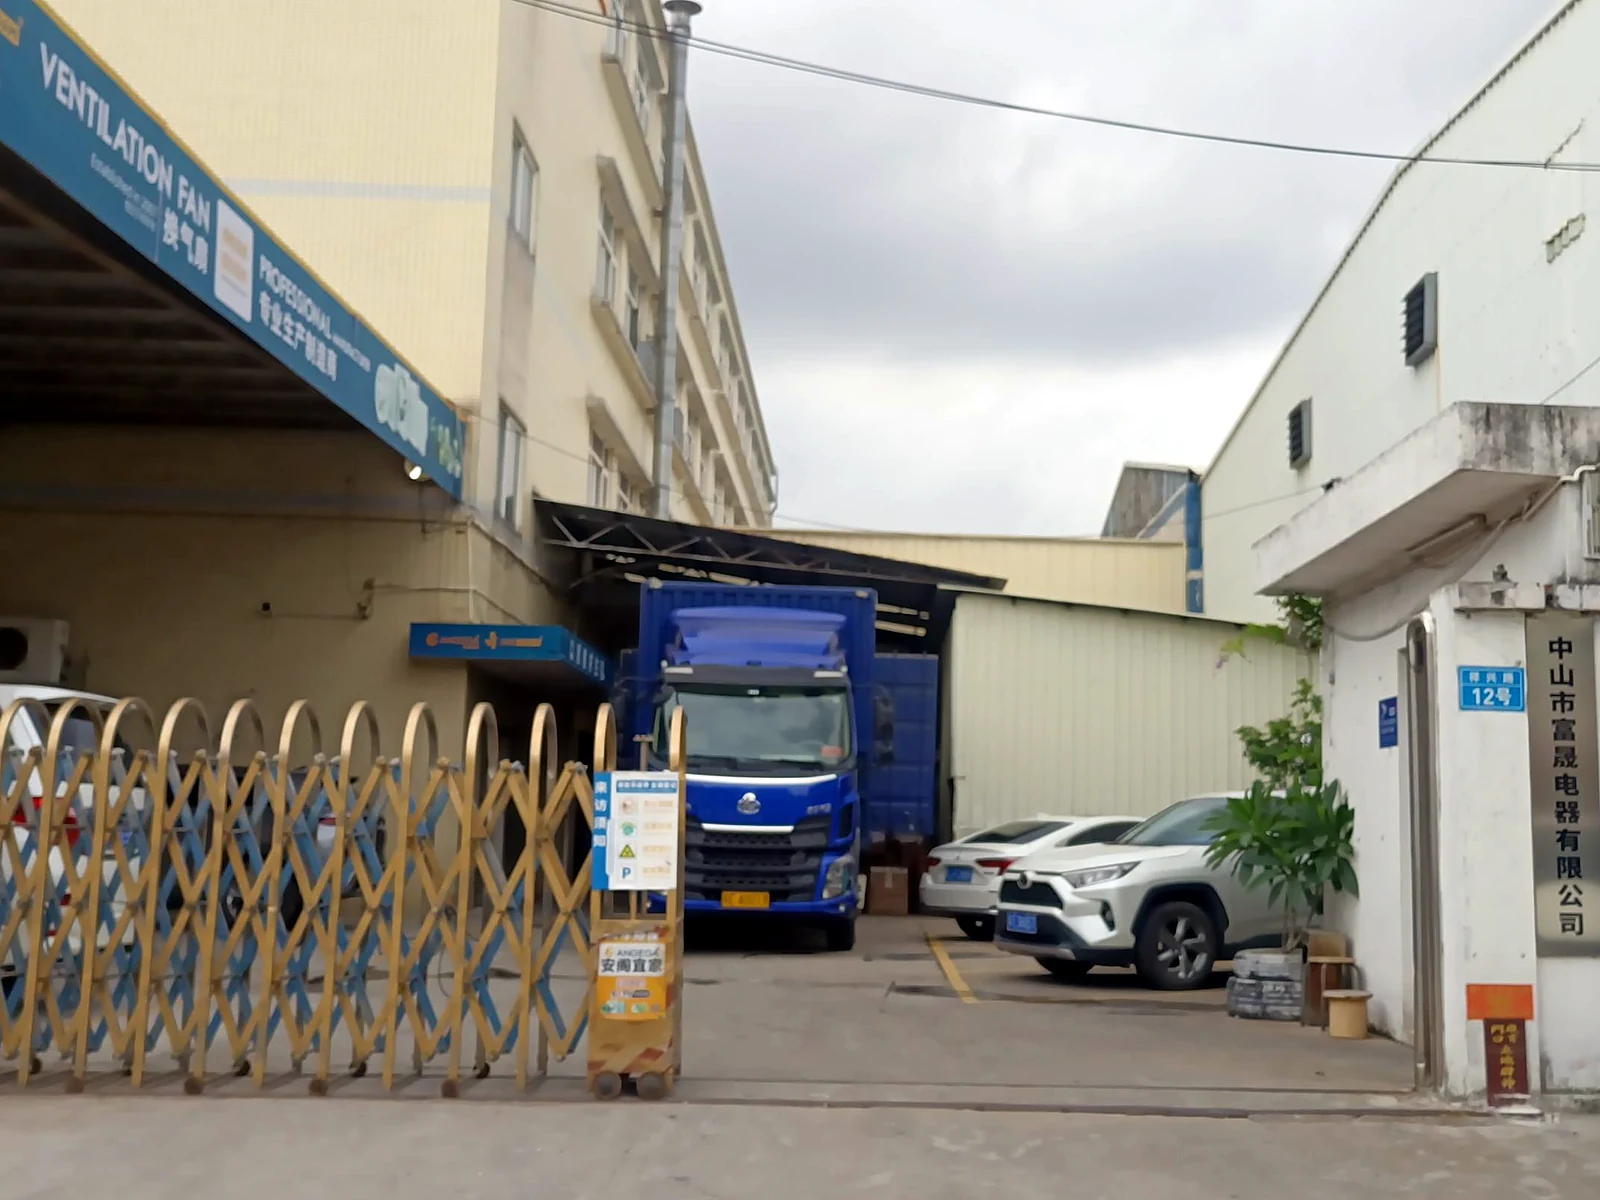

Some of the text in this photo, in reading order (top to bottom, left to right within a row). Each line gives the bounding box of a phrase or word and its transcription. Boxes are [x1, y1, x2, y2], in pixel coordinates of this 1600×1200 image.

[40, 41, 173, 199] VENTILATION
[177, 175, 210, 233] FAN
[260, 254, 332, 340] PROFESSIONAL
[1472, 687, 1512, 705] 12号
[1549, 637, 1584, 936] 中山市富晟电器有限公司
